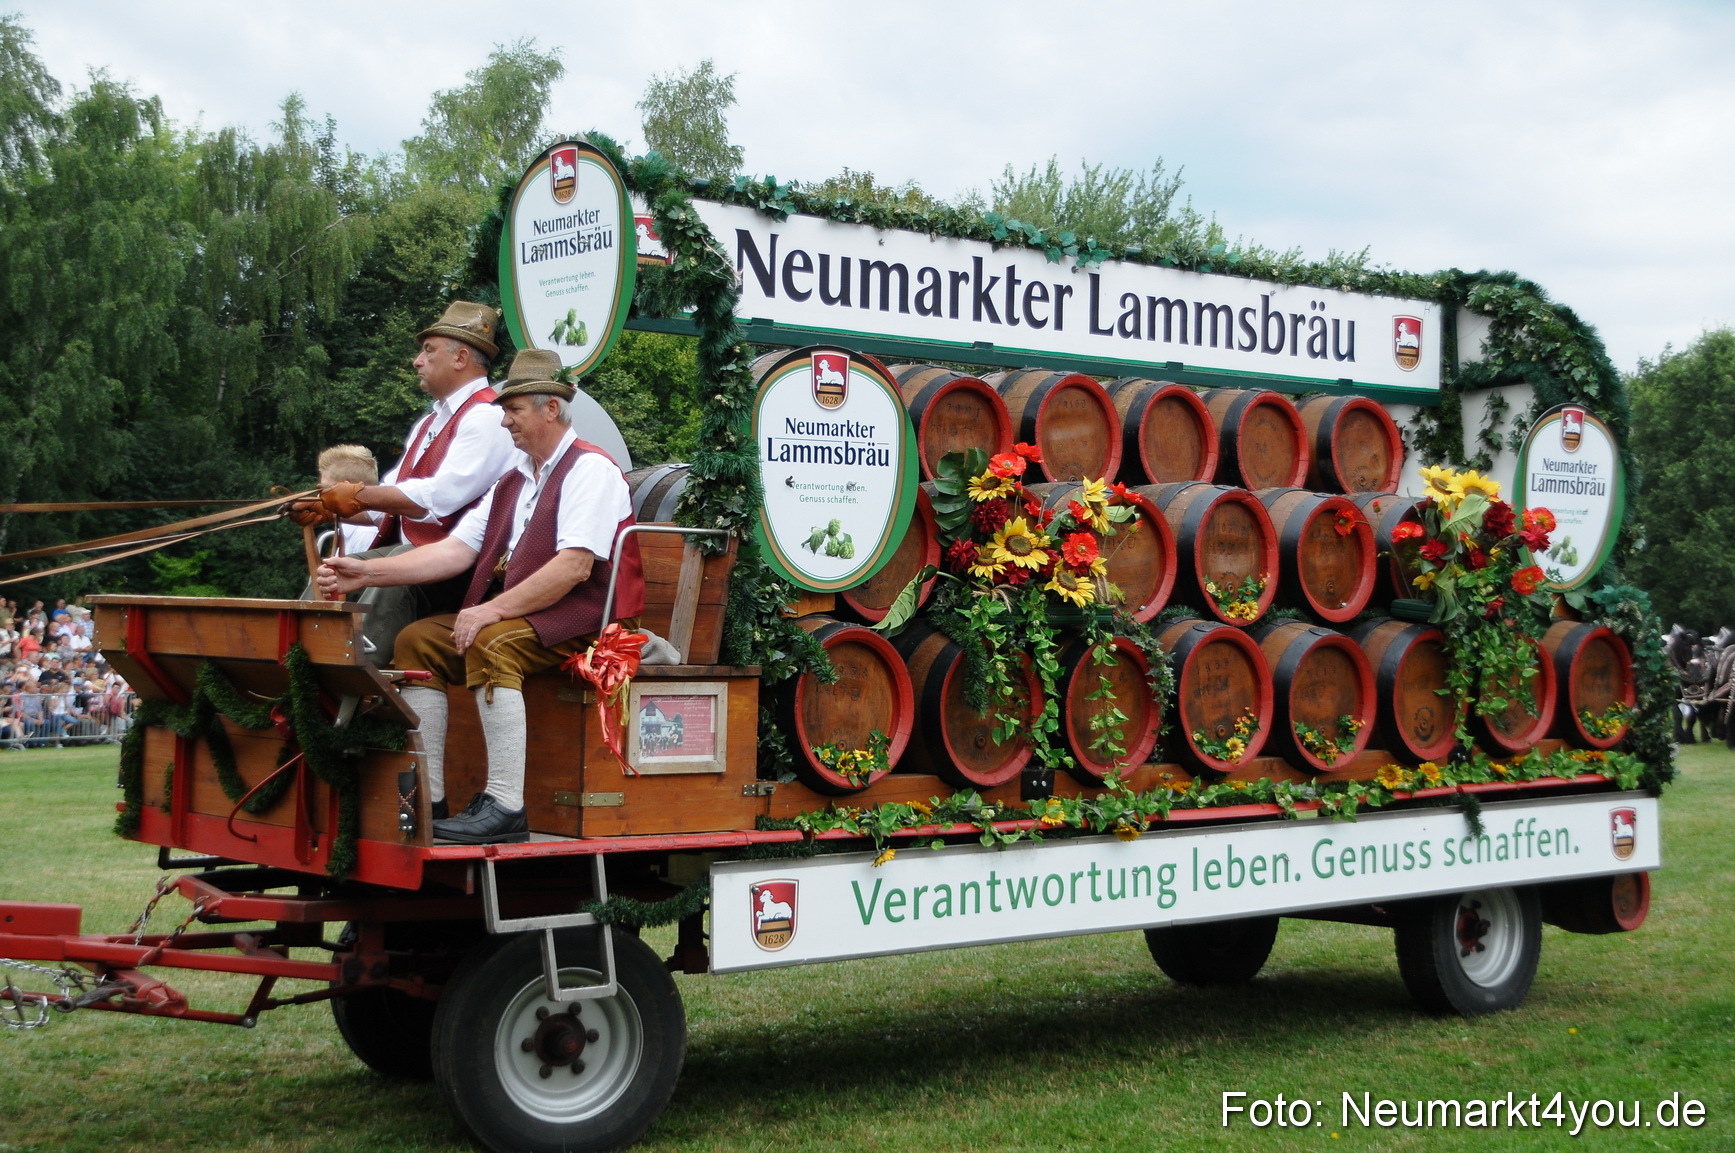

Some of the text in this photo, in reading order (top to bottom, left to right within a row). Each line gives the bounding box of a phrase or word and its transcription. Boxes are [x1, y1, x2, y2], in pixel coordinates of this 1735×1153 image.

[533, 209, 600, 236] Neumarkter
[521, 227, 613, 265] Lammsbräu
[539, 271, 596, 287] Verantwortung leben.
[545, 284, 590, 298] Genuss schaffen.
[735, 228, 1356, 363] Neumarkter Lammsbräu
[821, 395, 839, 405] 1628
[785, 417, 875, 439] Neumarkter
[767, 437, 890, 467] Lammsbräu
[1542, 457, 1598, 475] Neumarkter
[1531, 472, 1606, 497] Lammsbräu
[799, 494, 859, 504] Genuss schaffen.
[851, 817, 1579, 926] Verantwortung leben. Genuss schaffen.
[764, 933, 785, 945] 1628
